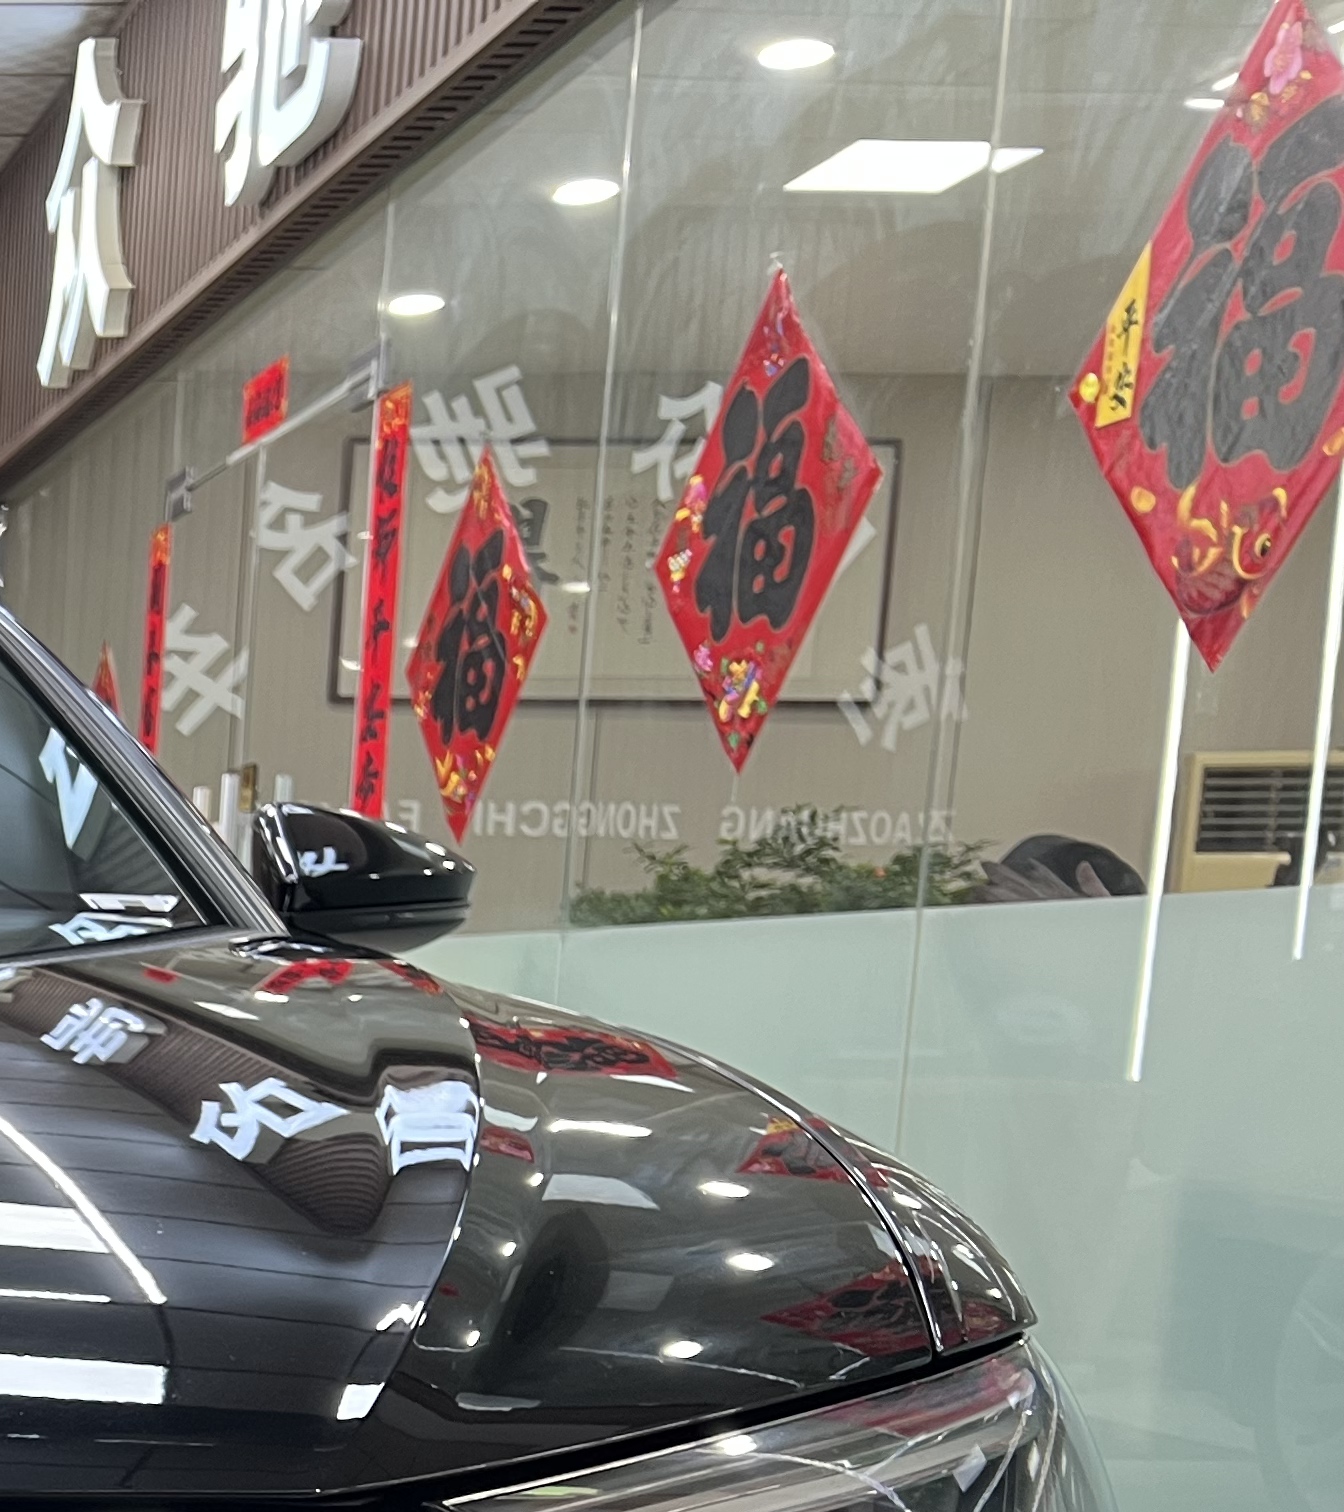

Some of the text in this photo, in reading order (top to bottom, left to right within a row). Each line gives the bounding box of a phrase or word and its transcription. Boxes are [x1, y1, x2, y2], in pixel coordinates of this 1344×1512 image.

[1139, 95, 1344, 490] 福
[429, 530, 507, 744] 福
[695, 355, 816, 642] 福
